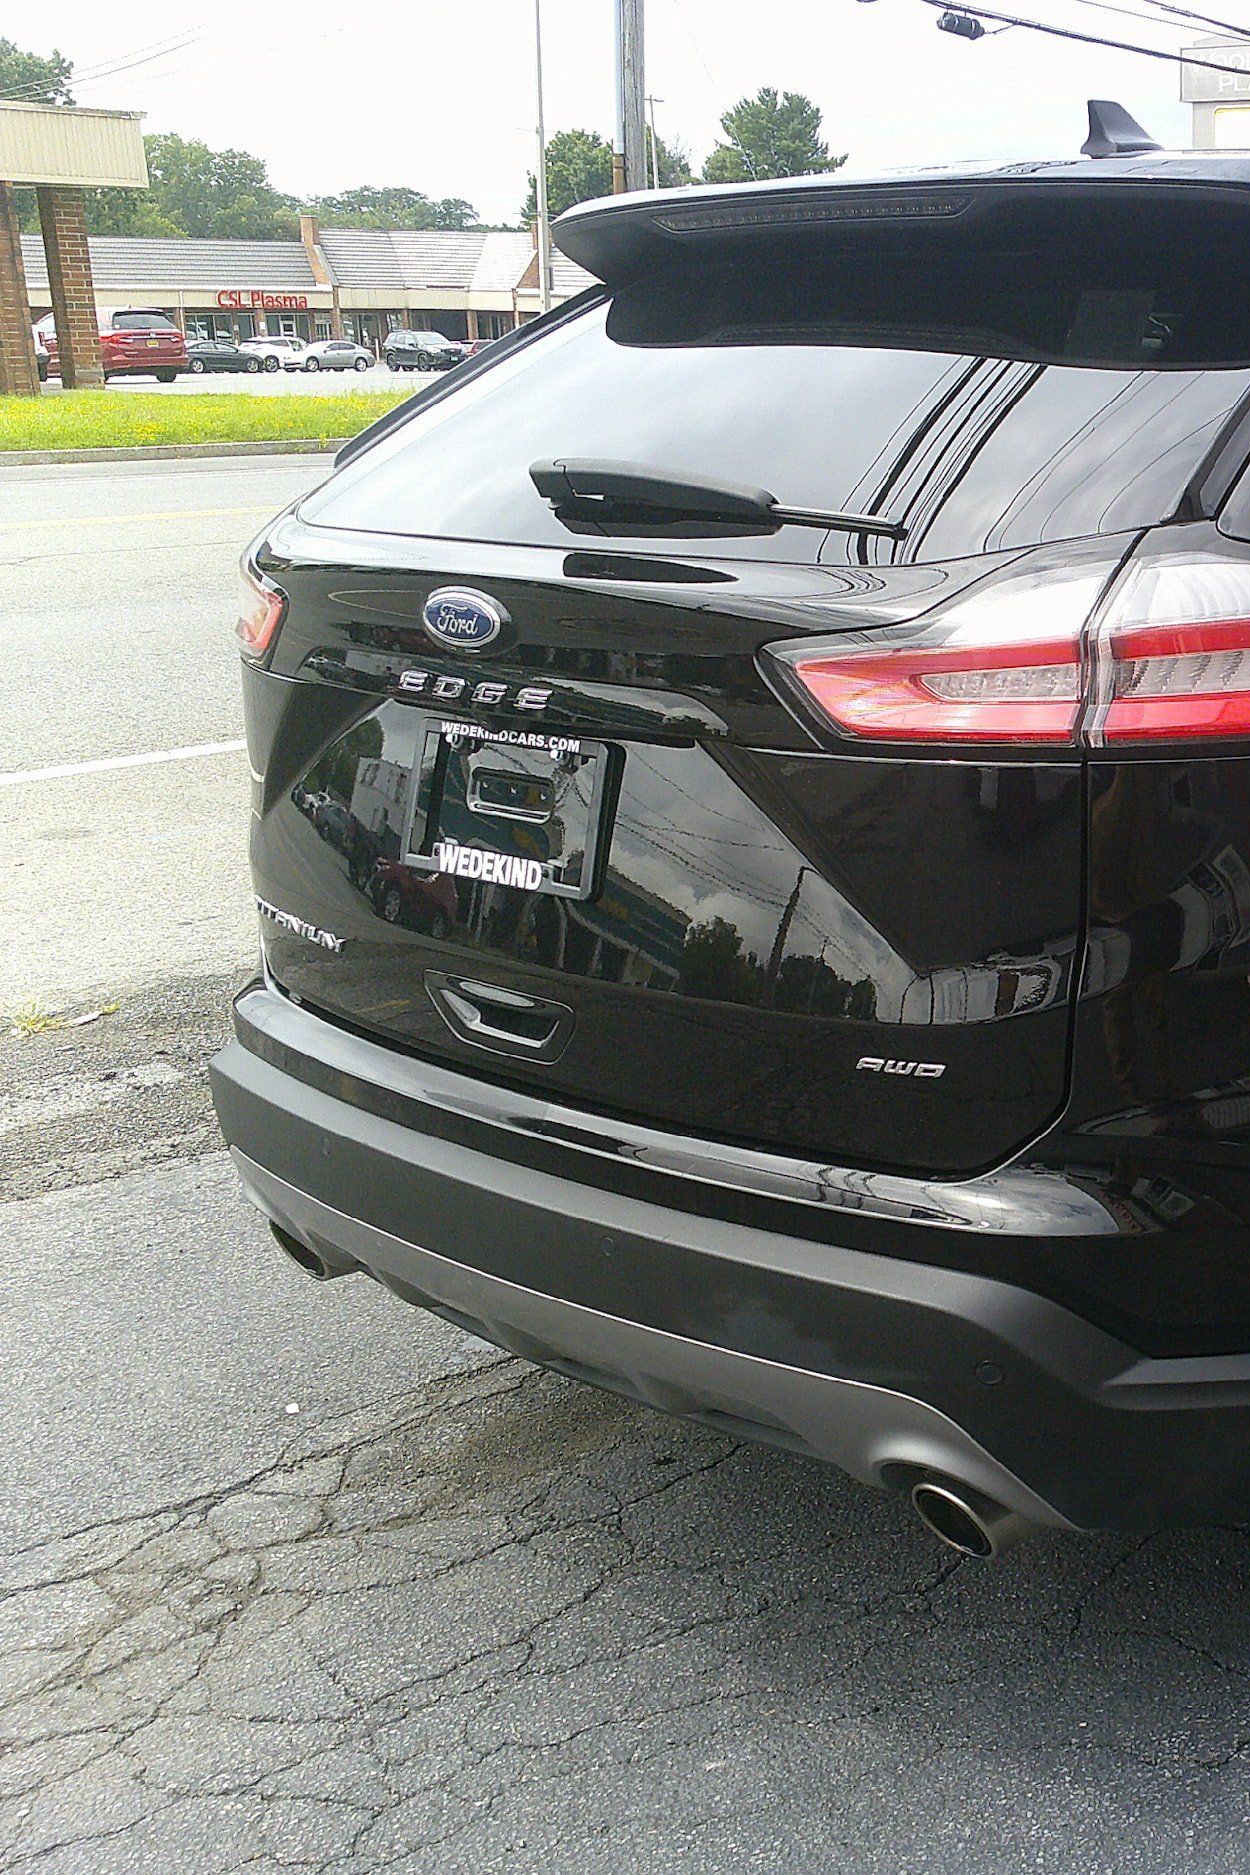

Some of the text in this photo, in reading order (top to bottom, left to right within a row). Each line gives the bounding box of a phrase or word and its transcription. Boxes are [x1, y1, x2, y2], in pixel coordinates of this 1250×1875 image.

[217, 290, 308, 308] CSL Plasma
[436, 603, 479, 635] Ford
[398, 669, 553, 710] EDGE
[438, 842, 543, 891] WEDEKIND
[254, 894, 346, 953] TITANIUM
[855, 1056, 947, 1078] AWD
